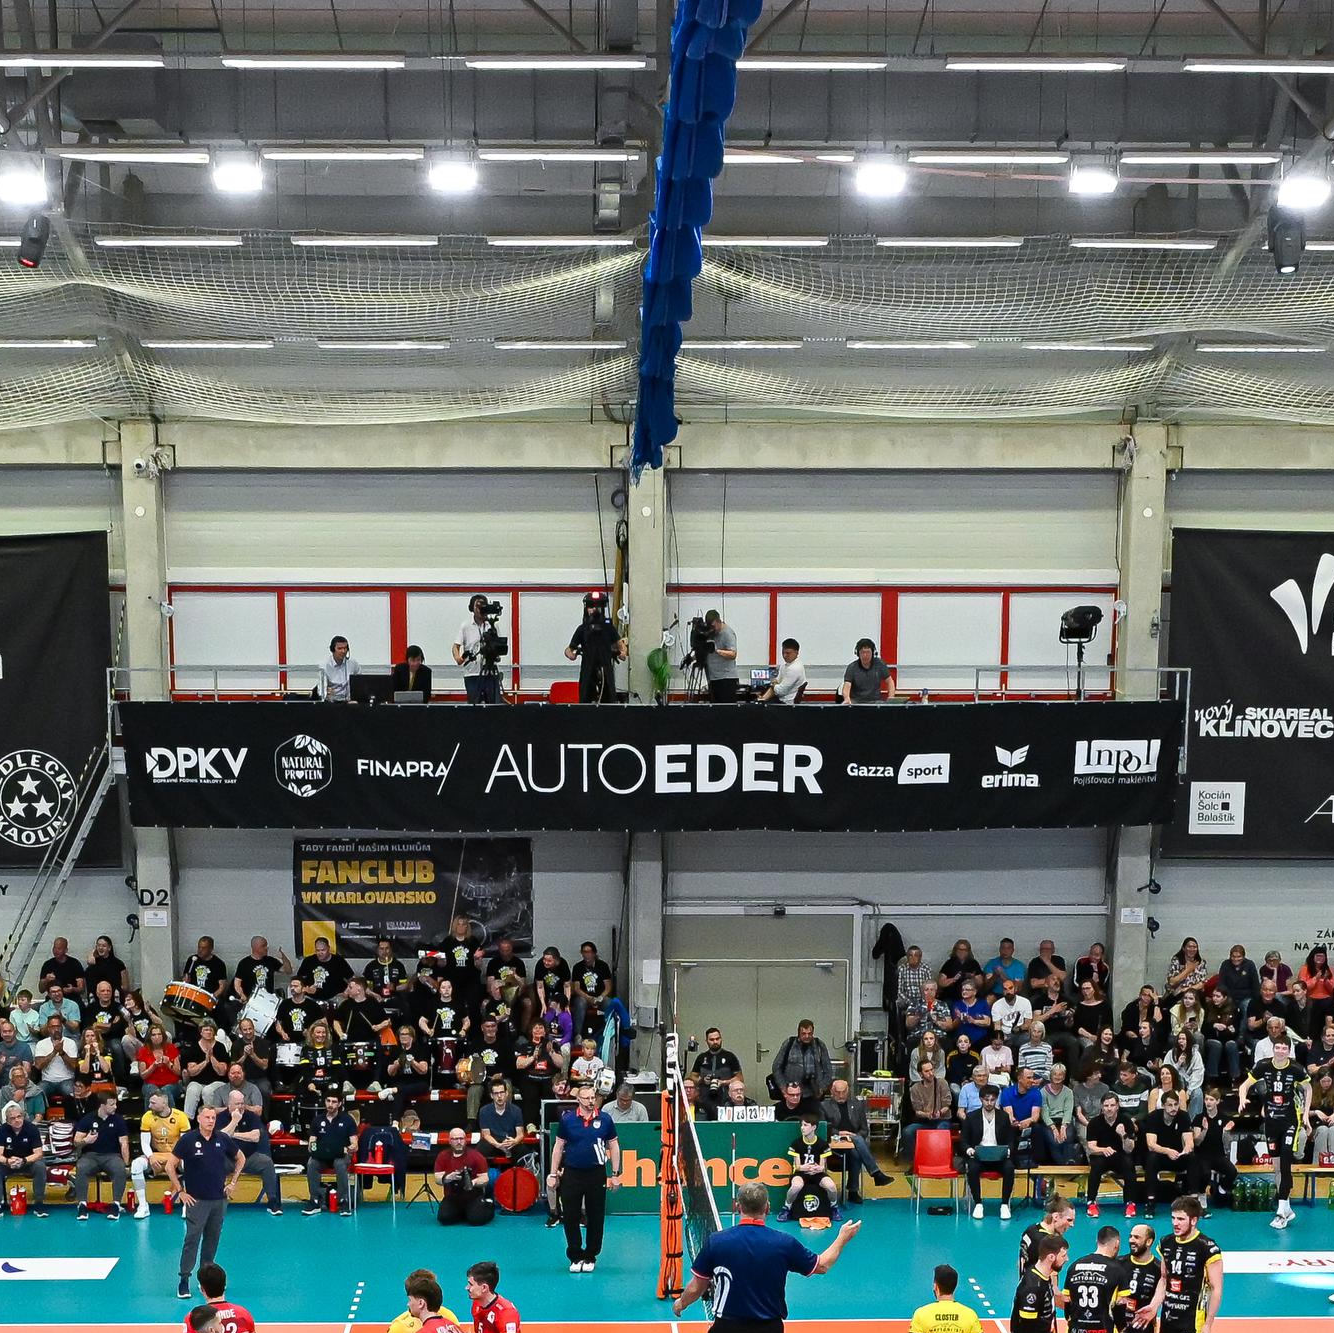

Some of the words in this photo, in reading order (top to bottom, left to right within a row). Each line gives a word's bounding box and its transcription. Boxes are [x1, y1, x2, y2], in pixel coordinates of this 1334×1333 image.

[1194, 700, 1234, 723] nový
[1244, 707, 1333, 721] SKIAREAL
[1199, 716, 1334, 739] KLÍNOVEC
[149, 747, 249, 779] DPKV
[281, 756, 325, 769] NATURAL
[484, 742, 824, 795] AUTOEDER
[846, 762, 895, 778] Gazza
[906, 763, 943, 779] sport
[981, 770, 1040, 788] erima
[1198, 790, 1232, 800] Kocián
[1197, 799, 1220, 811] Šolc
[301, 859, 436, 885] FANCLUB
[139, 889, 169, 907] D2
[301, 891, 324, 904] VK
[325, 891, 437, 905] KARLOVARSKO
[1294, 942, 1310, 951] NA
[1273, 1081, 1283, 1092] 19
[1170, 1260, 1183, 1275] 14
[1077, 1286, 1099, 1309] 33
